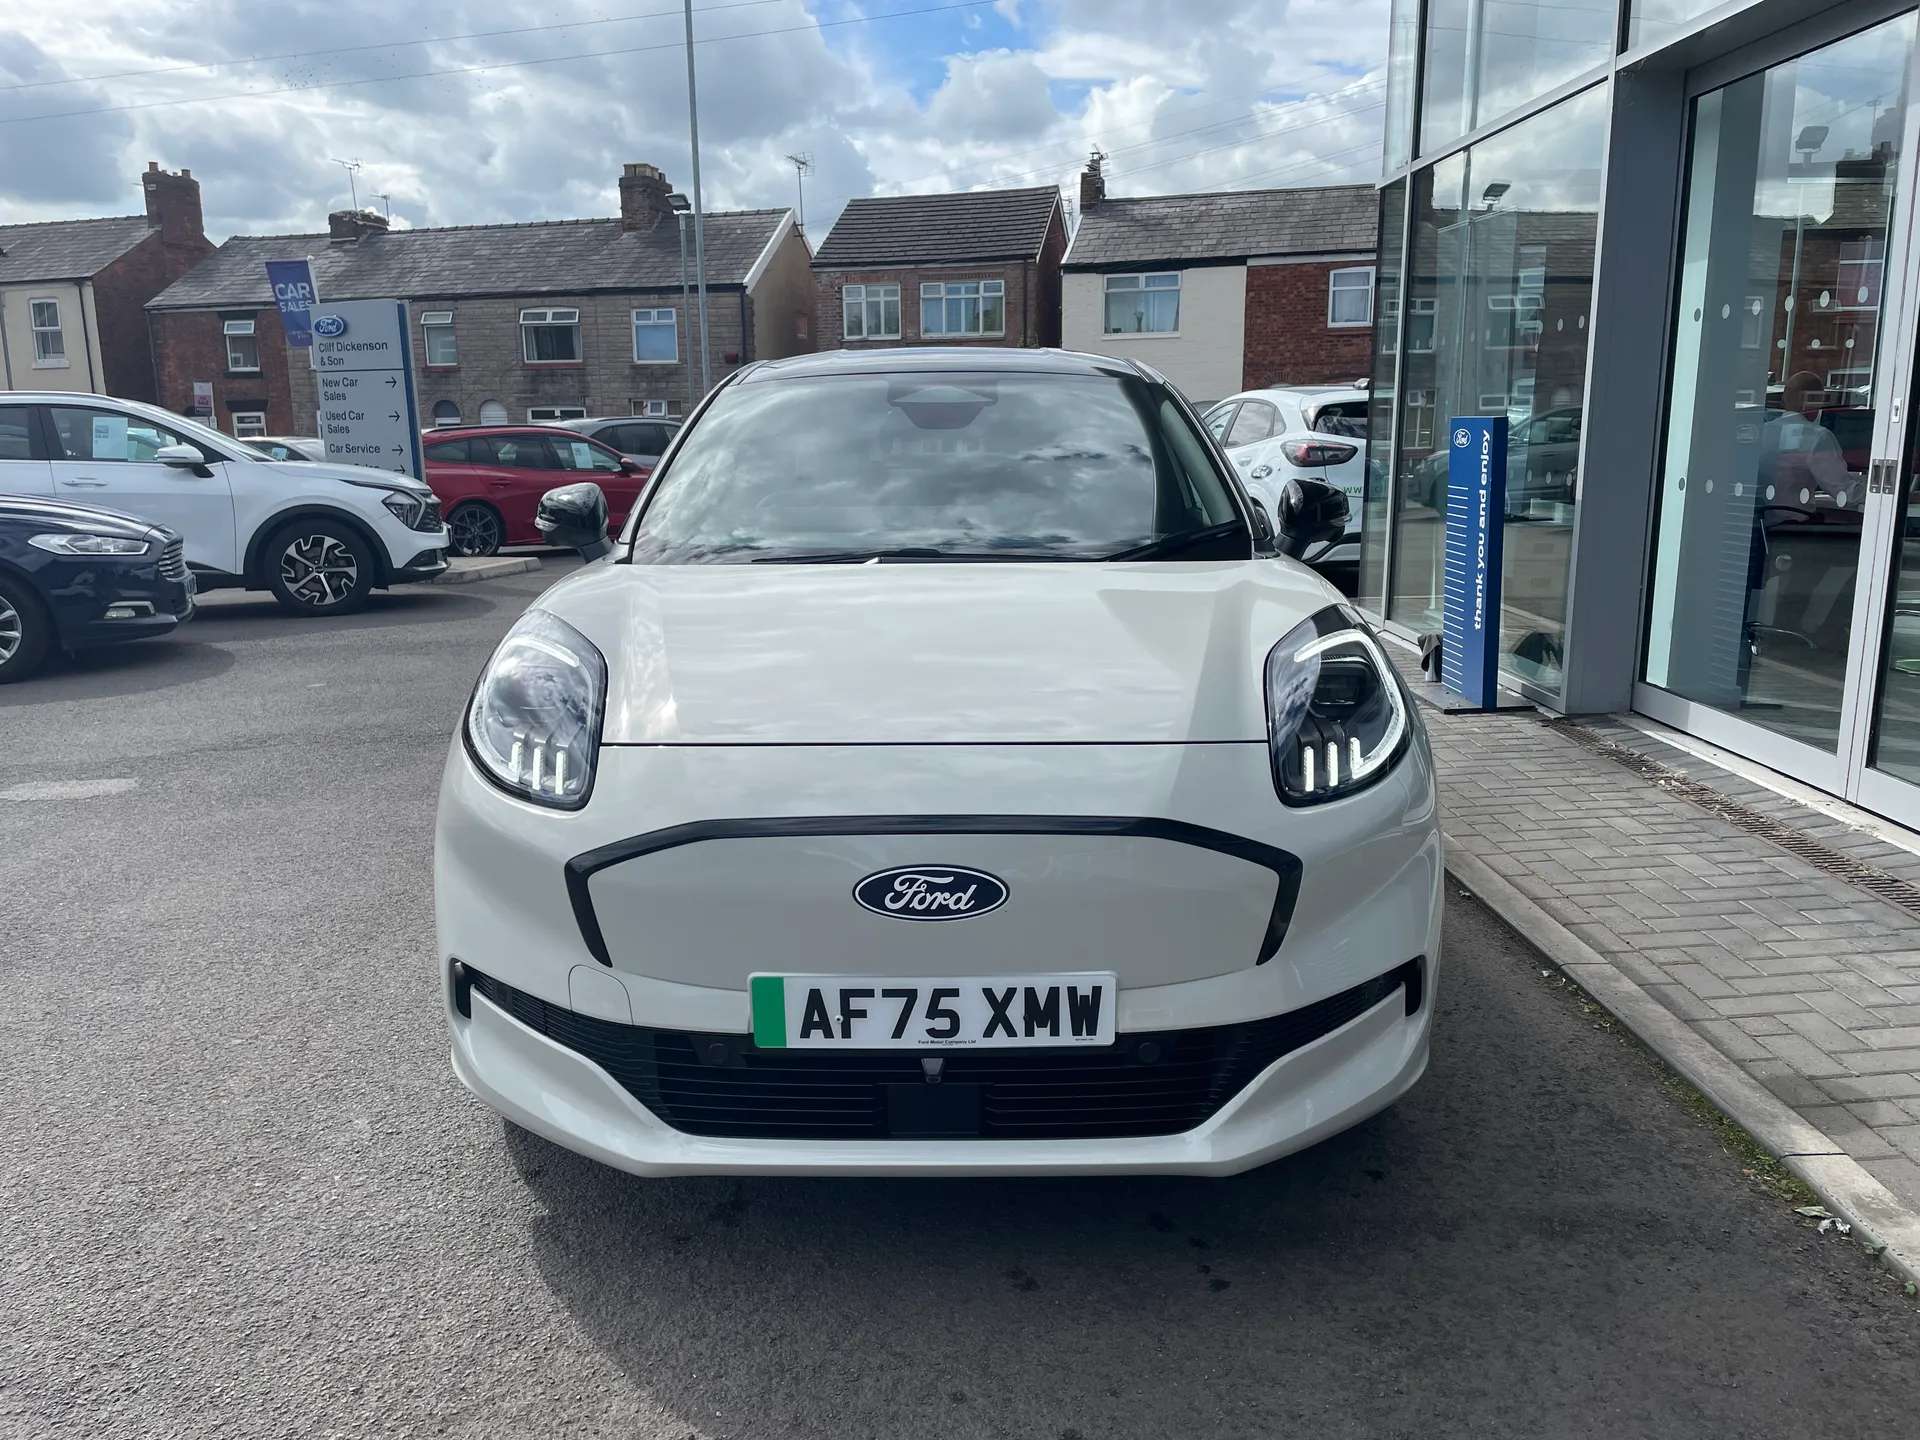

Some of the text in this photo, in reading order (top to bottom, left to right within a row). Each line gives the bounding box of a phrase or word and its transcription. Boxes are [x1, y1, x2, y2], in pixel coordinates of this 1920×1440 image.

[275, 282, 311, 299] CAR
[280, 300, 312, 312] SALES
[319, 341, 388, 352] Cliff Dickenson
[320, 355, 344, 366] & Son
[322, 377, 359, 388] New Car
[323, 391, 347, 401] Sales
[325, 410, 365, 421] Used Car
[327, 424, 350, 434] Sales
[329, 443, 381, 454] Car Service
[1474, 429, 1491, 630] thank you and enjoy
[885, 874, 978, 911] Ford
[799, 985, 1103, 1040] AF75 XMW
